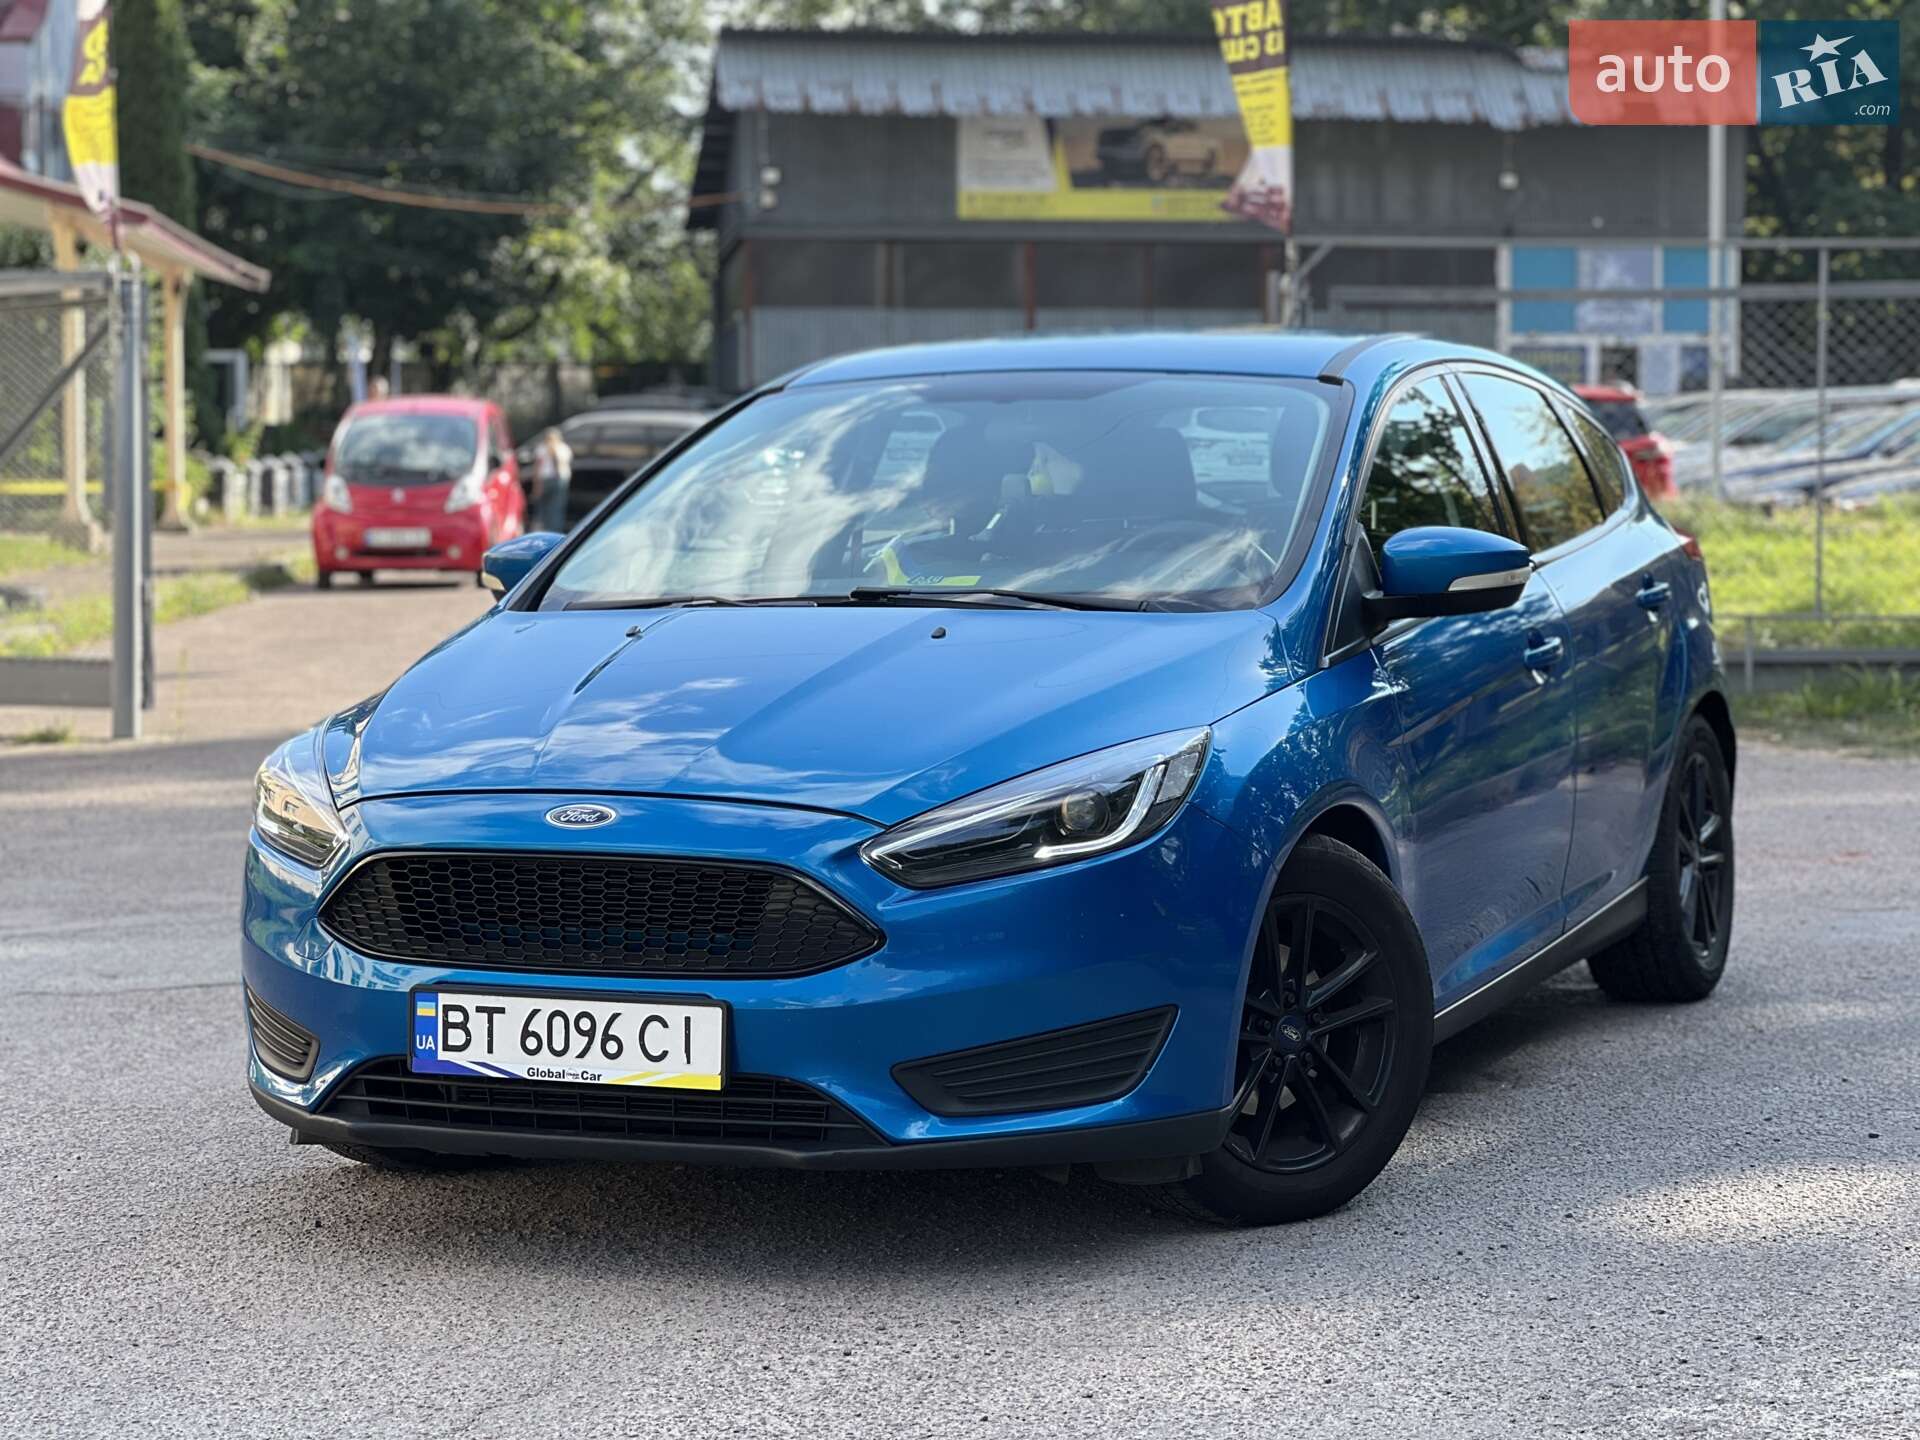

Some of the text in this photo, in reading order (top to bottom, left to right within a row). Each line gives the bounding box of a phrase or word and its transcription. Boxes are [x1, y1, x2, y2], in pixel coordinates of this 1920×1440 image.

[560, 808, 601, 822] Ford
[442, 1004, 691, 1064] BT 6096 CI
[416, 1034, 436, 1050] UA
[527, 1067, 566, 1079] Global
[581, 1070, 602, 1081] Car
